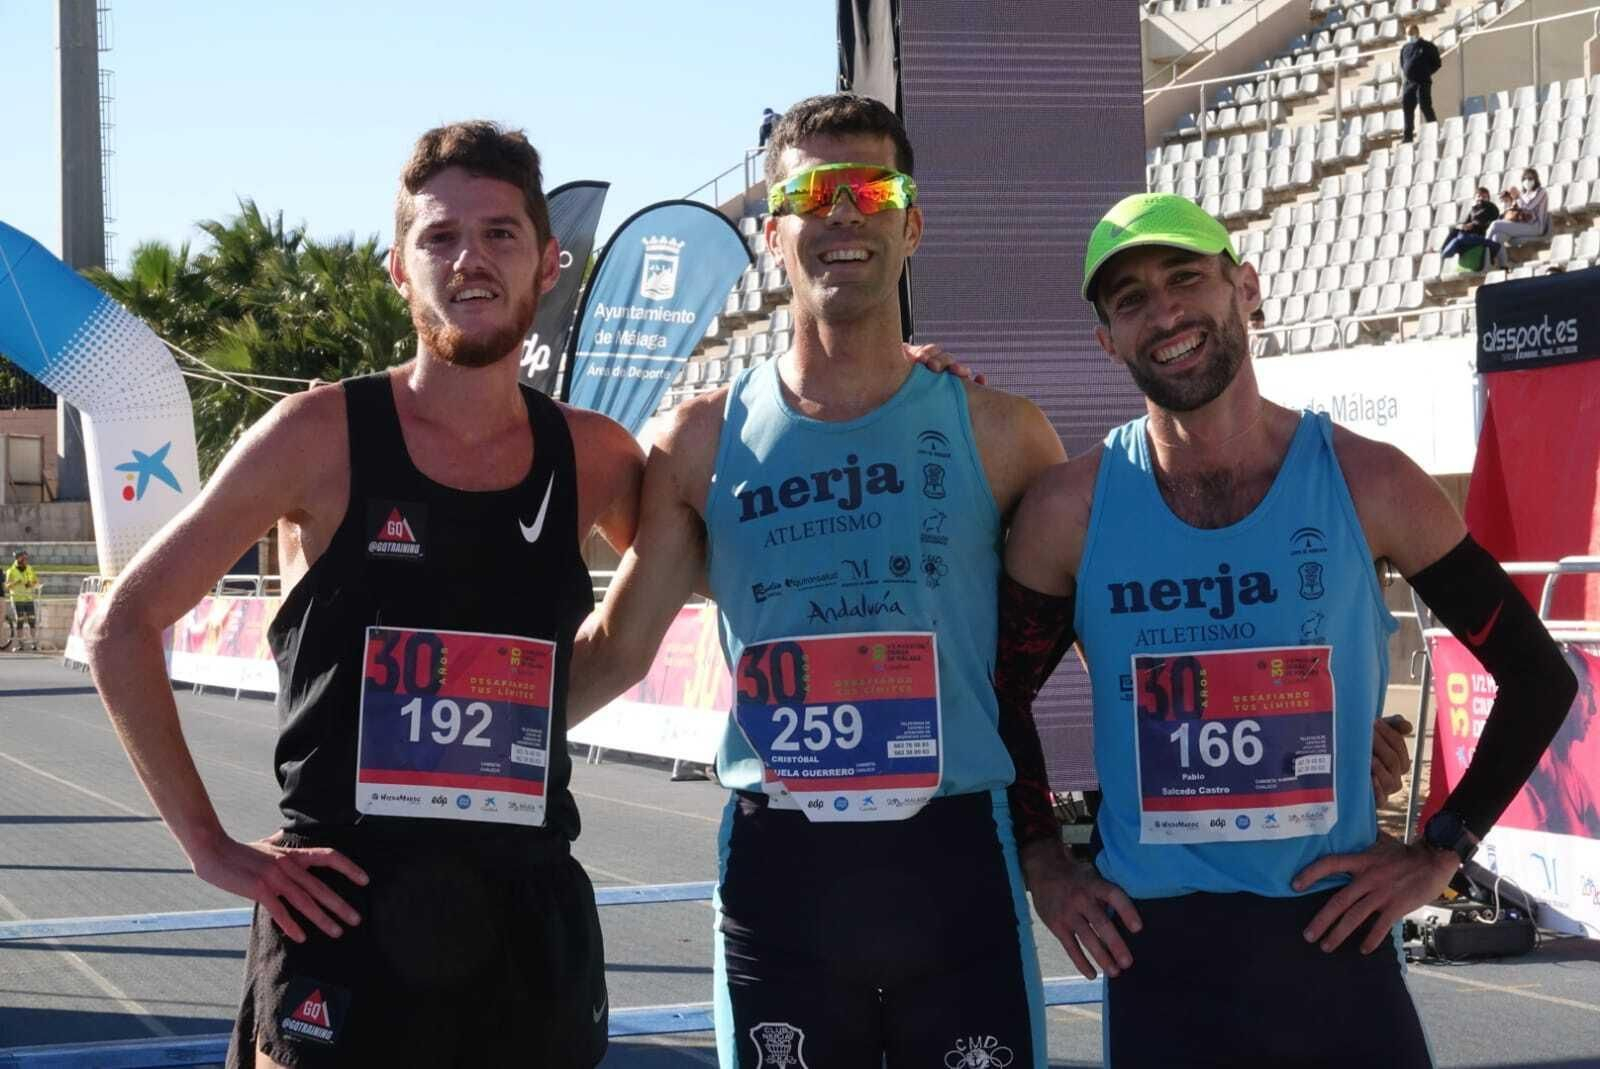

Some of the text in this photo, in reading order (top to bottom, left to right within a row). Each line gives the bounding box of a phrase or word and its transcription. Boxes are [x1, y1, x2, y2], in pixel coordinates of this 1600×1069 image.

[593, 302, 696, 324] Ayuntamiento
[594, 329, 668, 349] de Málaga
[628, 366, 672, 380] Deporte
[1332, 393, 1398, 426] Málaga
[737, 454, 904, 523] nerja
[763, 512, 883, 549] ATLETISMO
[1107, 562, 1278, 620] nerja
[1135, 622, 1256, 647] ATLETISMO
[365, 629, 445, 695] 30
[737, 640, 806, 705] 30
[1136, 654, 1204, 721] 30
[1232, 690, 1311, 703] DESAFIANDO
[400, 696, 493, 748] 192
[1233, 704, 1257, 712] TUS
[770, 703, 863, 752] 259
[1170, 719, 1264, 768] 166
[801, 768, 855, 778] GUERRERO
[1182, 771, 1205, 781] Pablo
[1161, 786, 1231, 796] Salcedo Castro
[954, 1034, 998, 1051] CMD
